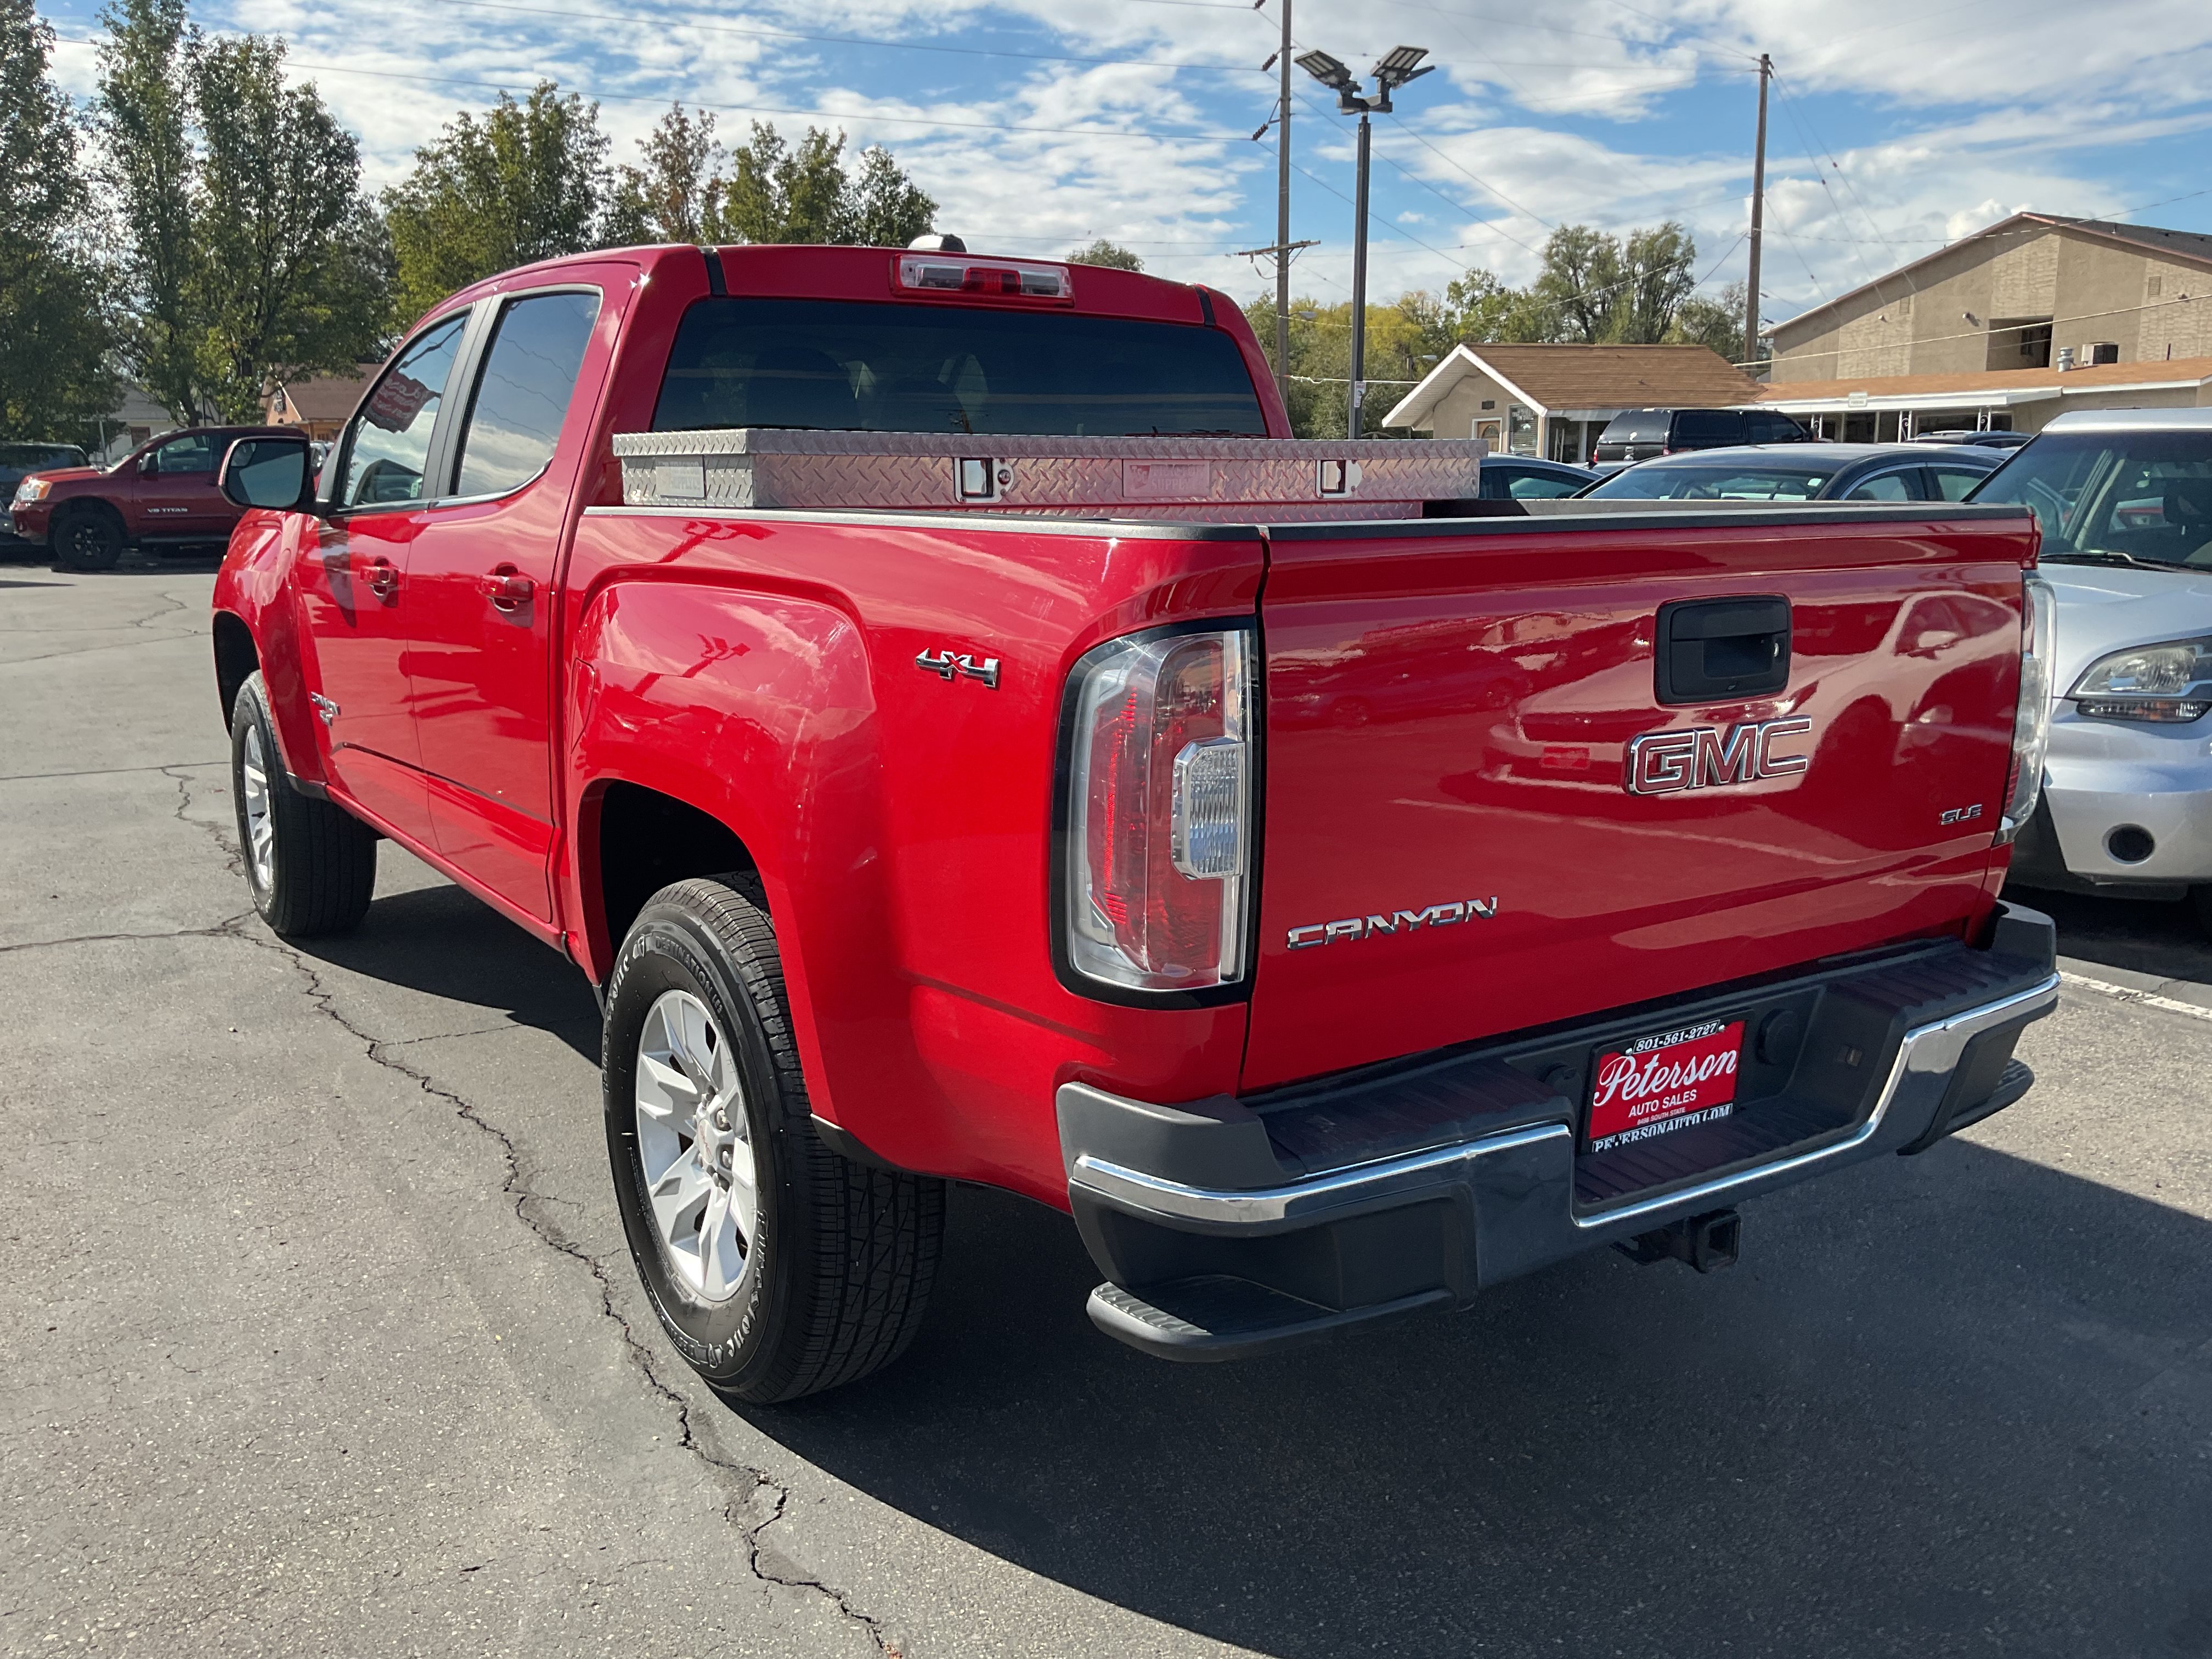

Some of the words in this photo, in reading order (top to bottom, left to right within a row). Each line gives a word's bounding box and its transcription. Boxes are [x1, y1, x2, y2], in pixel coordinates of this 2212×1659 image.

[1152, 478, 1190, 490] SUPPLY
[1622, 714, 1812, 796] GMC
[1940, 803, 1983, 825] SLE
[1286, 895, 1498, 950] CANYON
[1635, 1022, 1718, 1052] 801-561-2727
[1593, 1049, 1737, 1107] Peterson
[1628, 1099, 1660, 1118] AUTO
[1662, 1088, 1697, 1108] SALES
[1650, 1111, 1669, 1121] SOUTH
[1669, 1107, 1686, 1116] STATE
[1594, 1105, 1730, 1152] PEERSONAUTOOM
